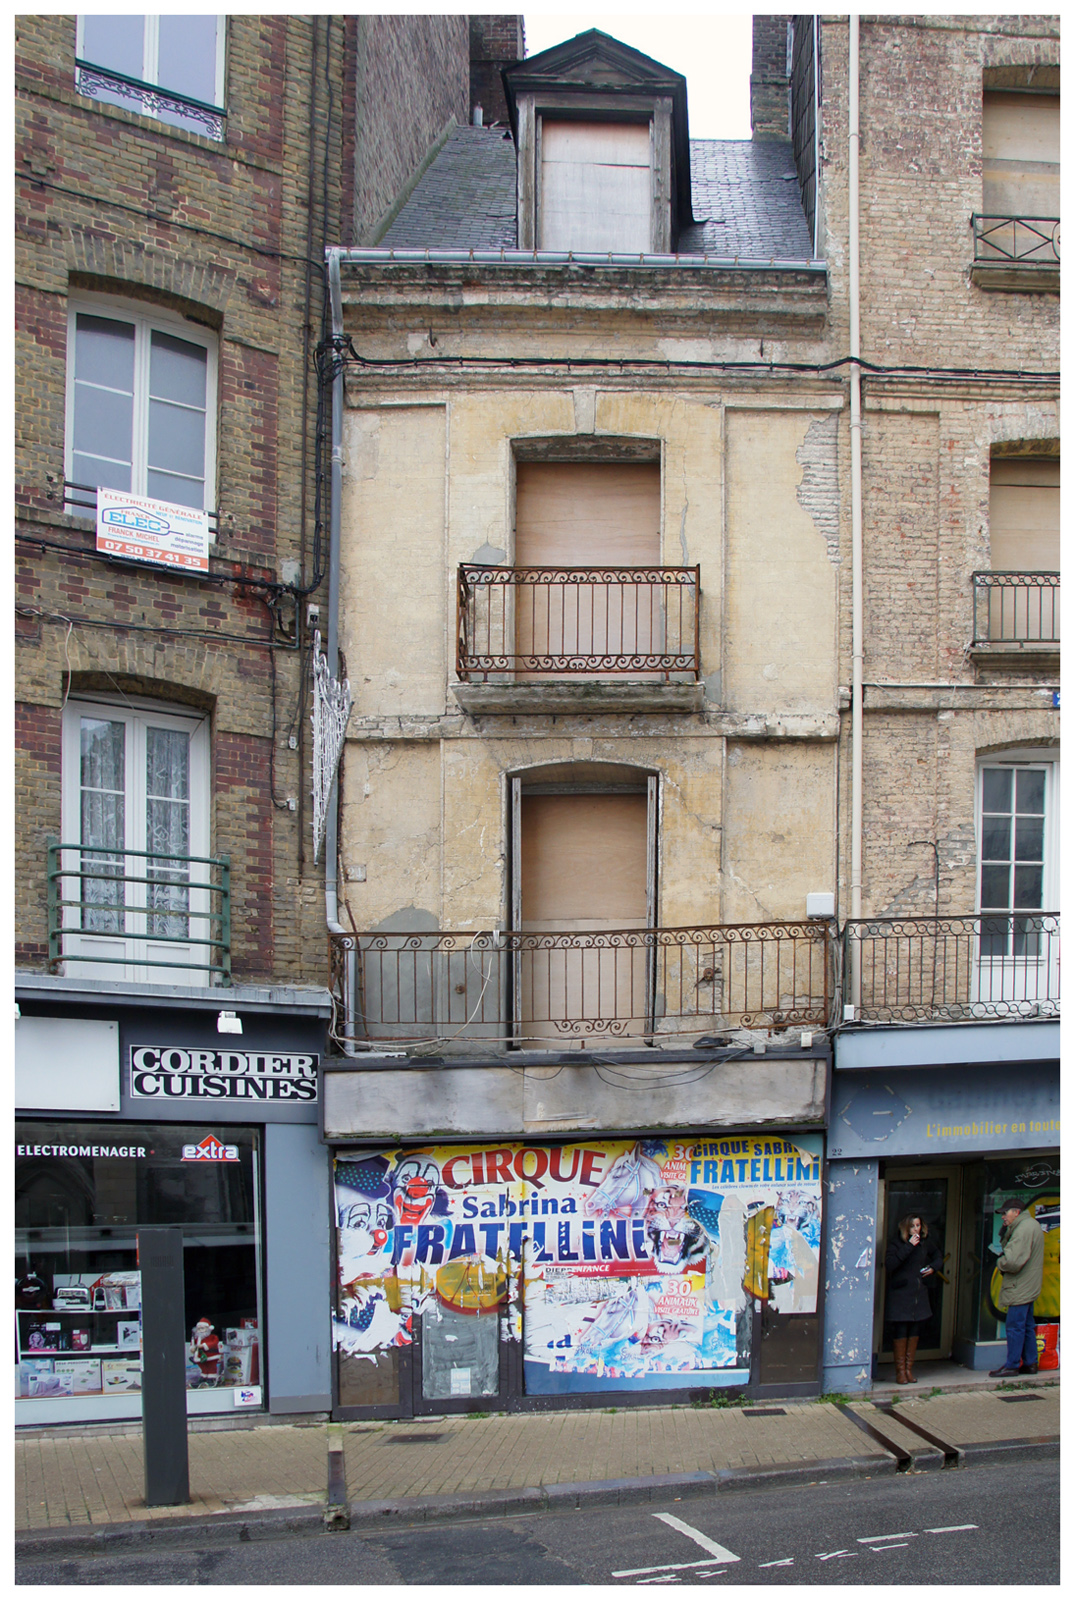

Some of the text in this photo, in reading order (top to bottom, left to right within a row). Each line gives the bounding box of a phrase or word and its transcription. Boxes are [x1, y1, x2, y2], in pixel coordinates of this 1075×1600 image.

[109, 511, 161, 532] ELEC
[108, 526, 134, 537] FRANCK
[136, 532, 160, 543] MICHEL
[105, 541, 123, 551] 07
[125, 545, 143, 555] 50
[146, 549, 163, 559] 37
[165, 553, 180, 563] 41
[184, 556, 201, 566] 35
[133, 1047, 317, 1078] CORDIER
[134, 1072, 317, 1100] CUISINES
[926, 1120, 1008, 1138] L'immobilier
[1011, 1120, 1026, 1133] en
[17, 1144, 146, 1158] ELECTROMENAGER
[183, 1140, 239, 1160] extra
[831, 1147, 843, 1156] 22
[441, 1148, 606, 1190] CIRQUE
[462, 1191, 578, 1220] Sabrina
[667, 1279, 692, 1297] 30
